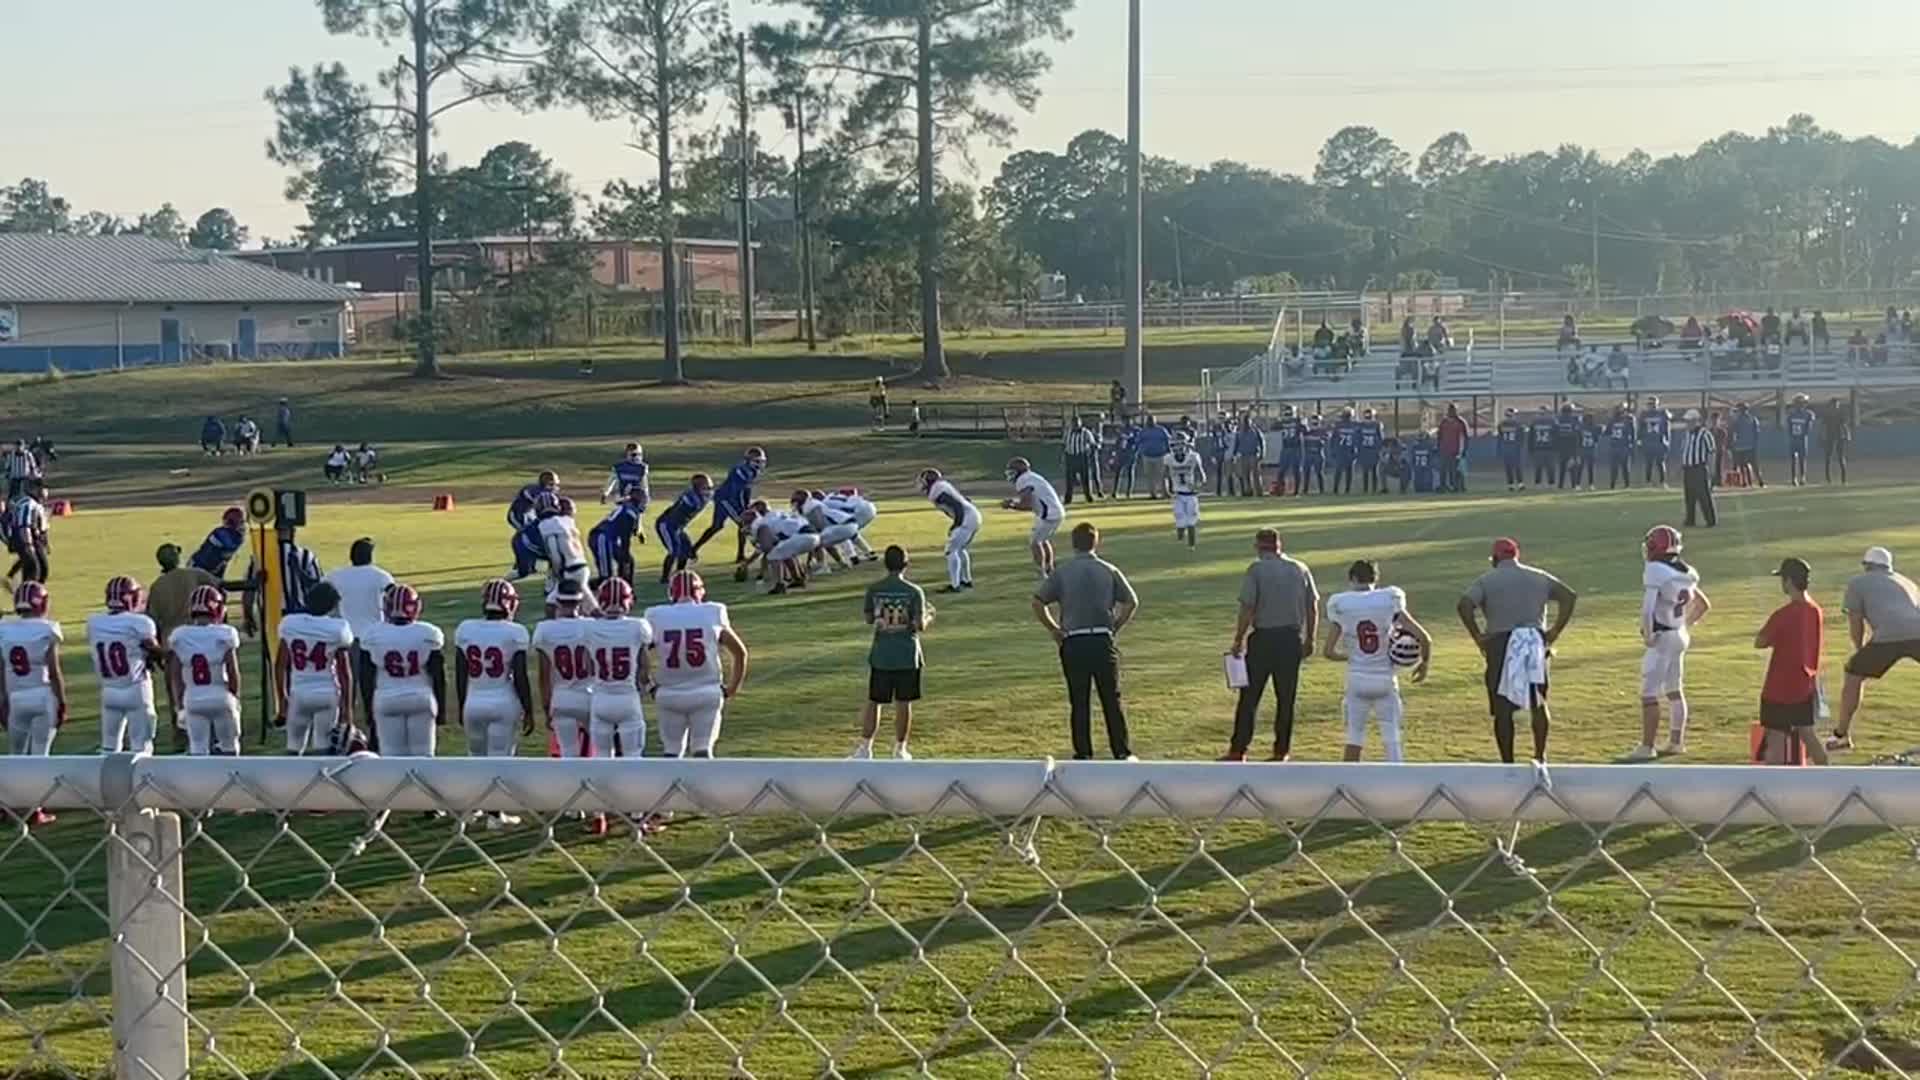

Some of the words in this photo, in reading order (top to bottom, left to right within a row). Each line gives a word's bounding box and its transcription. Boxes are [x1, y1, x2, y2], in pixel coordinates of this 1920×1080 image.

[281, 492, 296, 519] 1
[663, 628, 706, 669] 75
[1357, 619, 1379, 654] 6
[9, 646, 31, 677] 9
[96, 641, 130, 678] 10
[191, 653, 212, 686] 8
[290, 638, 329, 671] 64
[384, 650, 421, 677] 61
[466, 644, 505, 678] 63
[596, 646, 632, 681] 15
